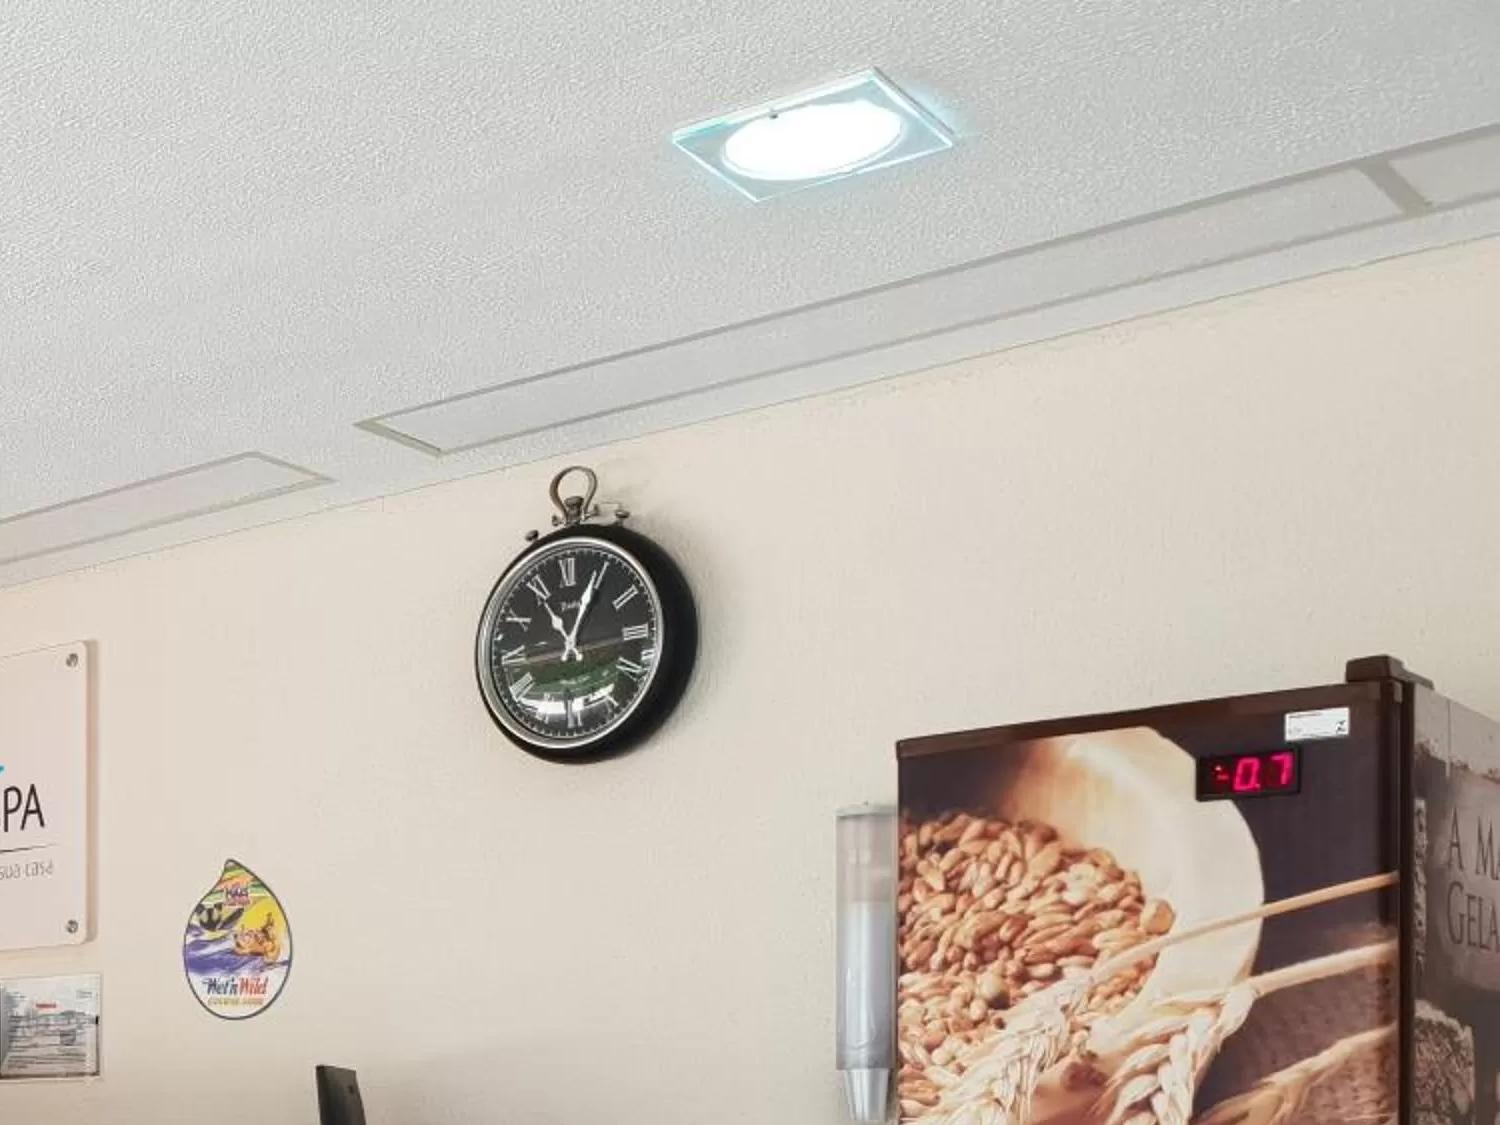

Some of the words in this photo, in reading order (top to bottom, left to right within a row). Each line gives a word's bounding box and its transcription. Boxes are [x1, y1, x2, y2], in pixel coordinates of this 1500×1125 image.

[1449, 804, 1466, 871] A
[24, 860, 54, 879] casa
[240, 977, 270, 996] Wild
